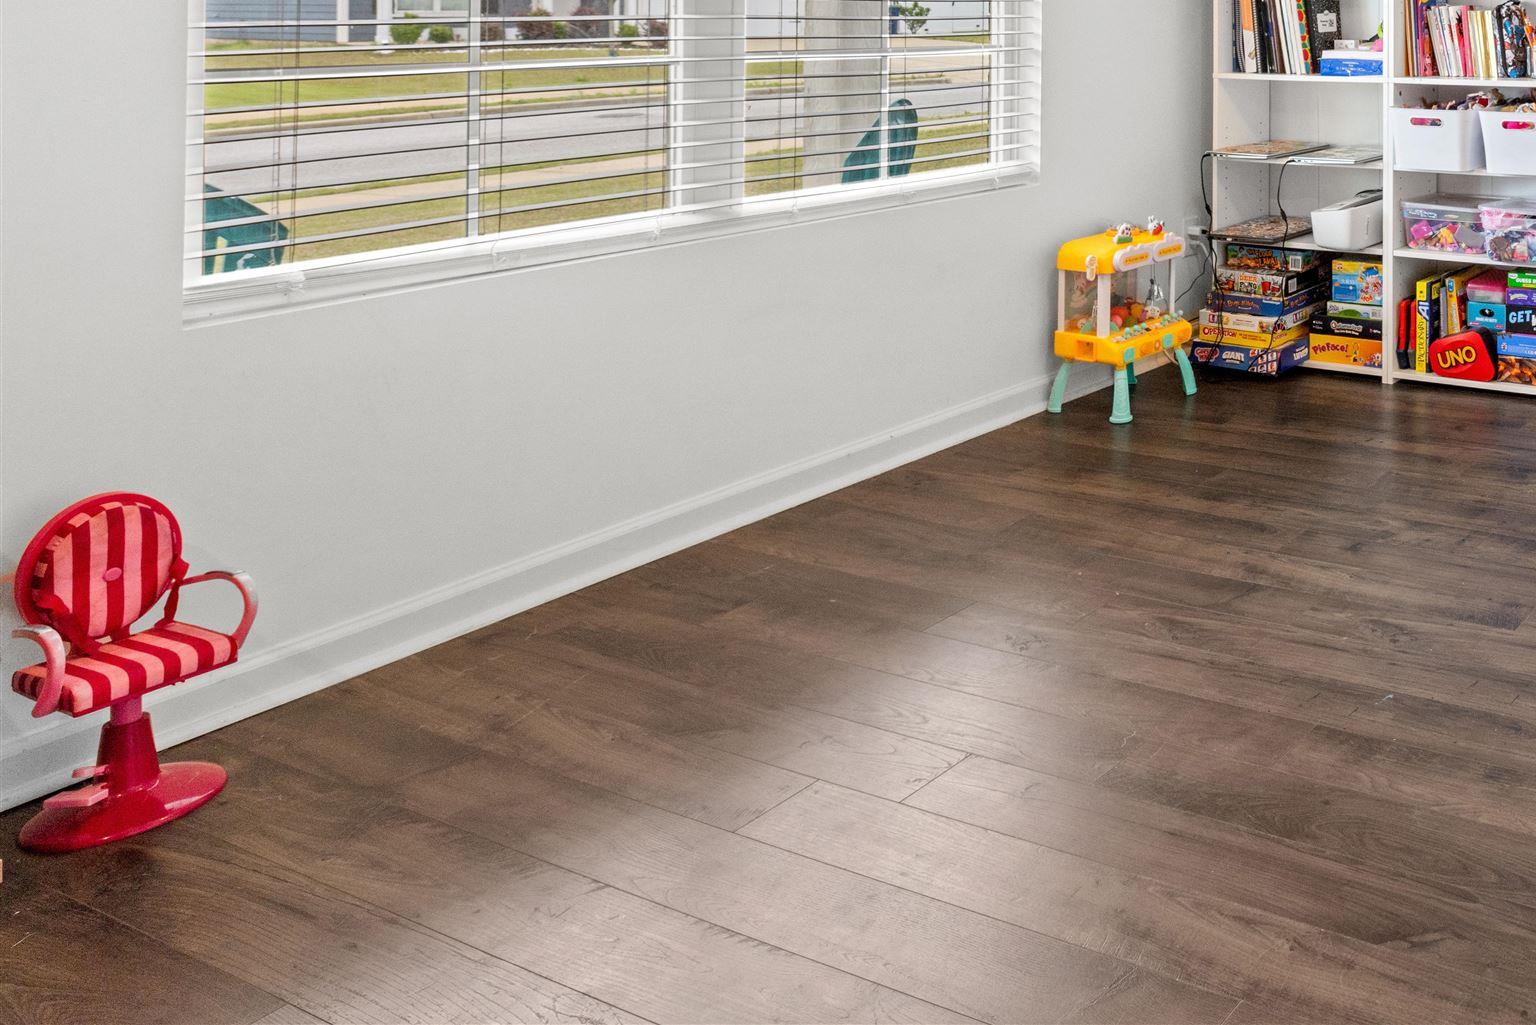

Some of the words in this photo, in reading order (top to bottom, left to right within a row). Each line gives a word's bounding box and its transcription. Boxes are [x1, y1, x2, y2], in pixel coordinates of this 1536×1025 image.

[1509, 310, 1532, 324] GET
[1417, 321, 1425, 364] PICTIONARY
[1437, 345, 1476, 368] UNO
